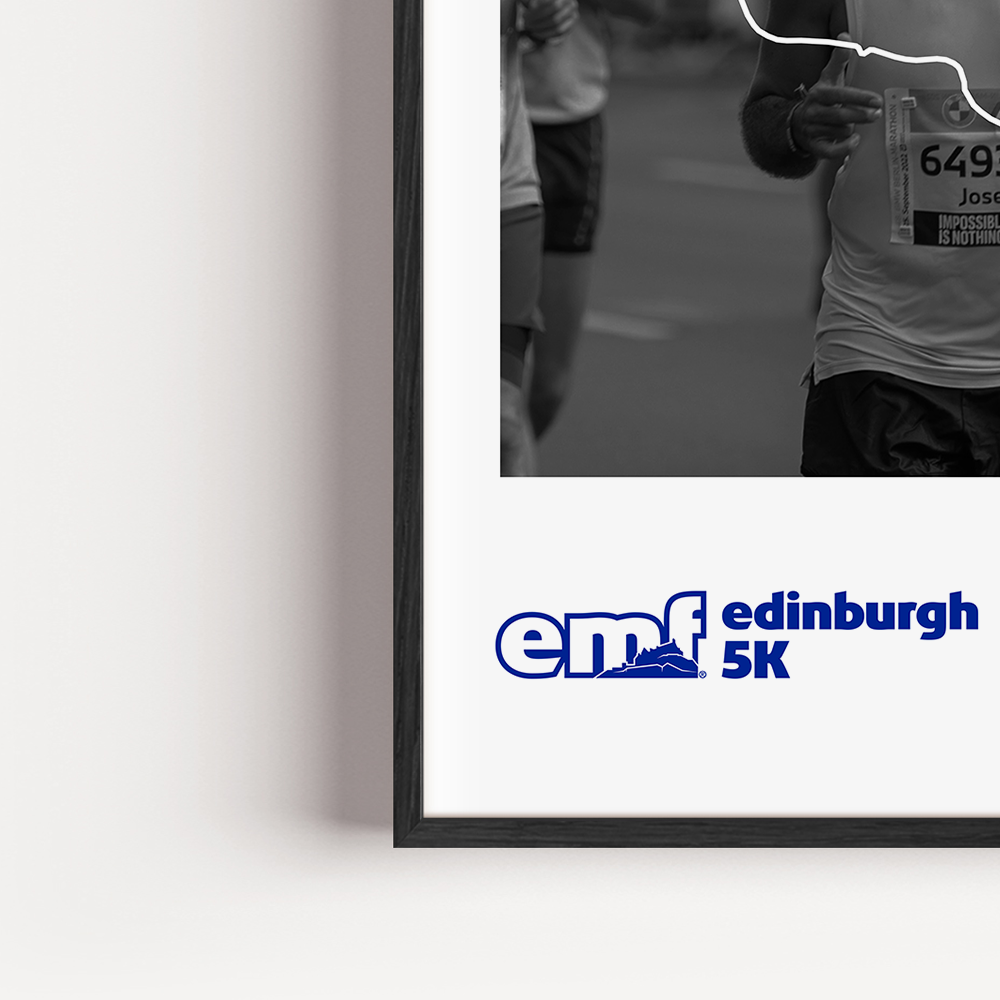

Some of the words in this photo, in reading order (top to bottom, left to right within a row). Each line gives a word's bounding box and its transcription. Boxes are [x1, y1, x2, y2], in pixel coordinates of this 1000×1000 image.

[938, 230, 951, 245] IS
[722, 591, 979, 640] edinburgh
[722, 640, 790, 679] 5K
